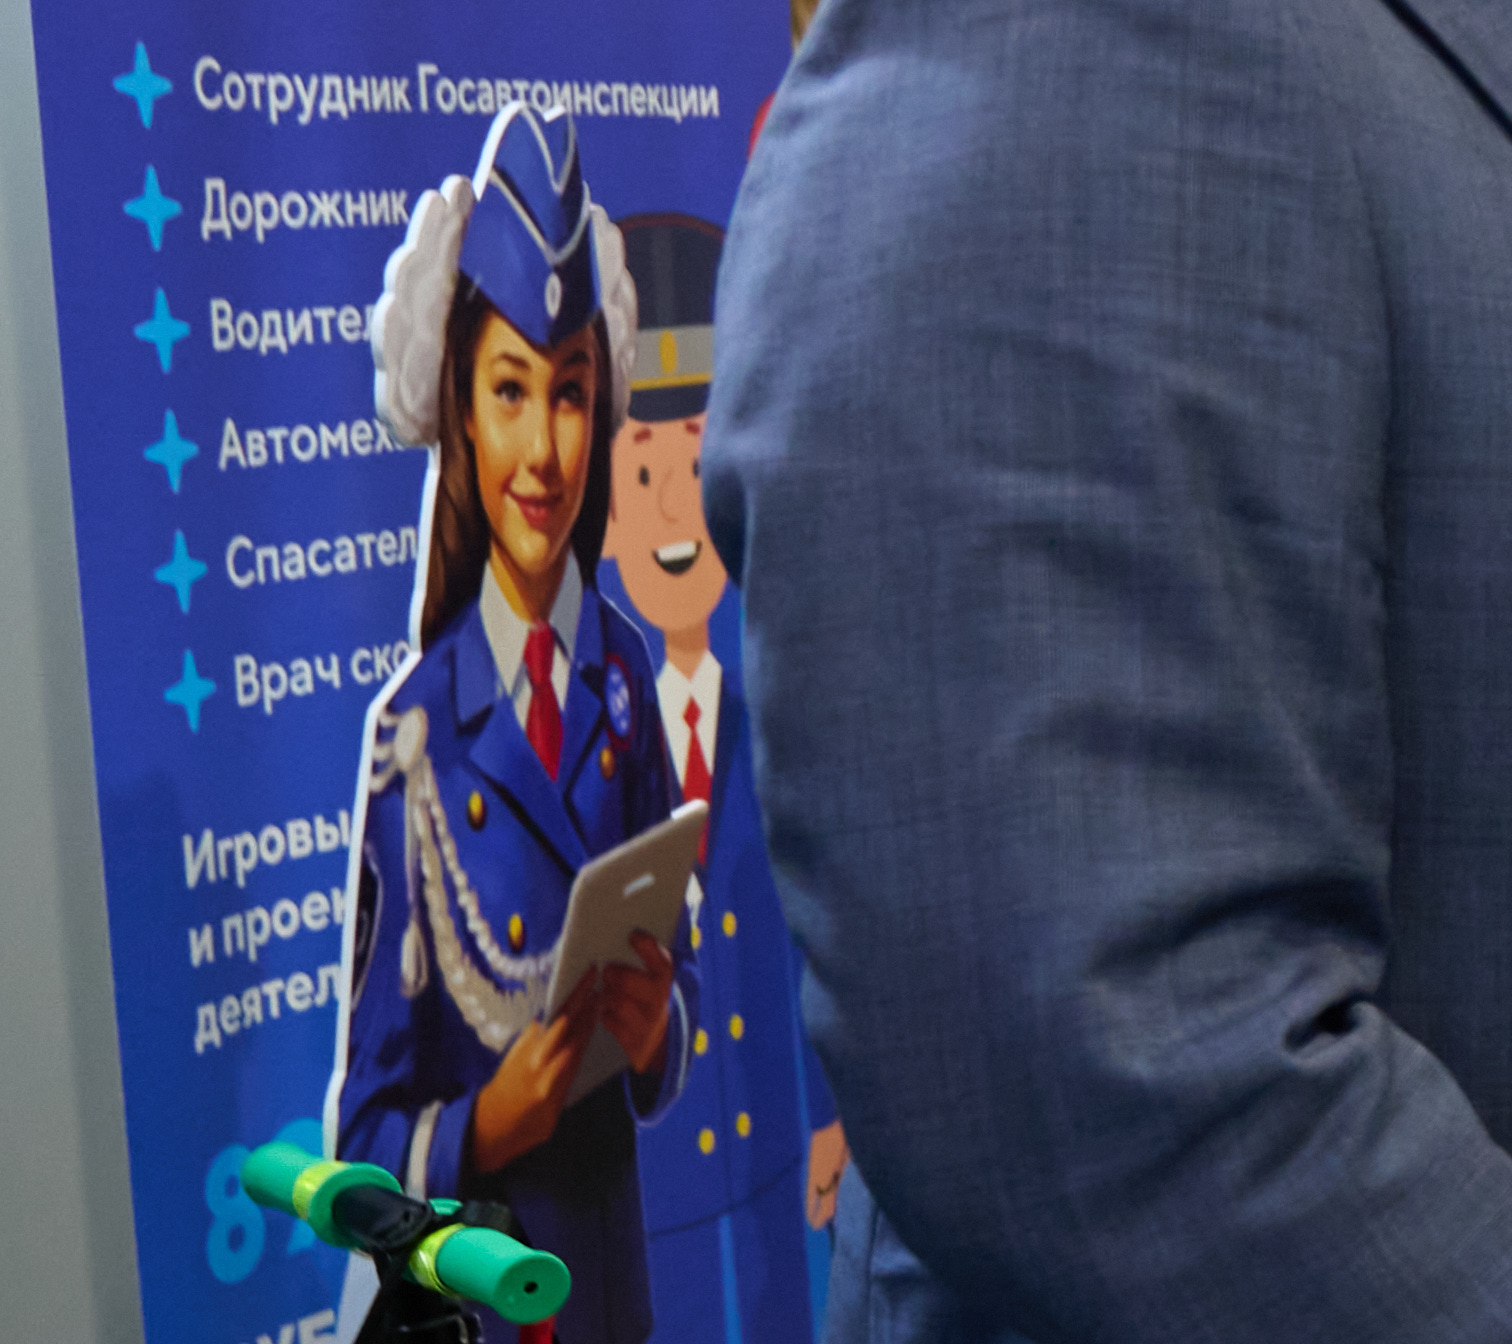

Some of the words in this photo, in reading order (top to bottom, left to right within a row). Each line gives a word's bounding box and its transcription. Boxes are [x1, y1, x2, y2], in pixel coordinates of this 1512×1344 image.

[193, 55, 412, 126] Сотрудник
[417, 61, 719, 122] Госавтоинспекции
[201, 177, 410, 244] Дорожник
[234, 652, 341, 716] Врач
[189, 923, 215, 968] и
